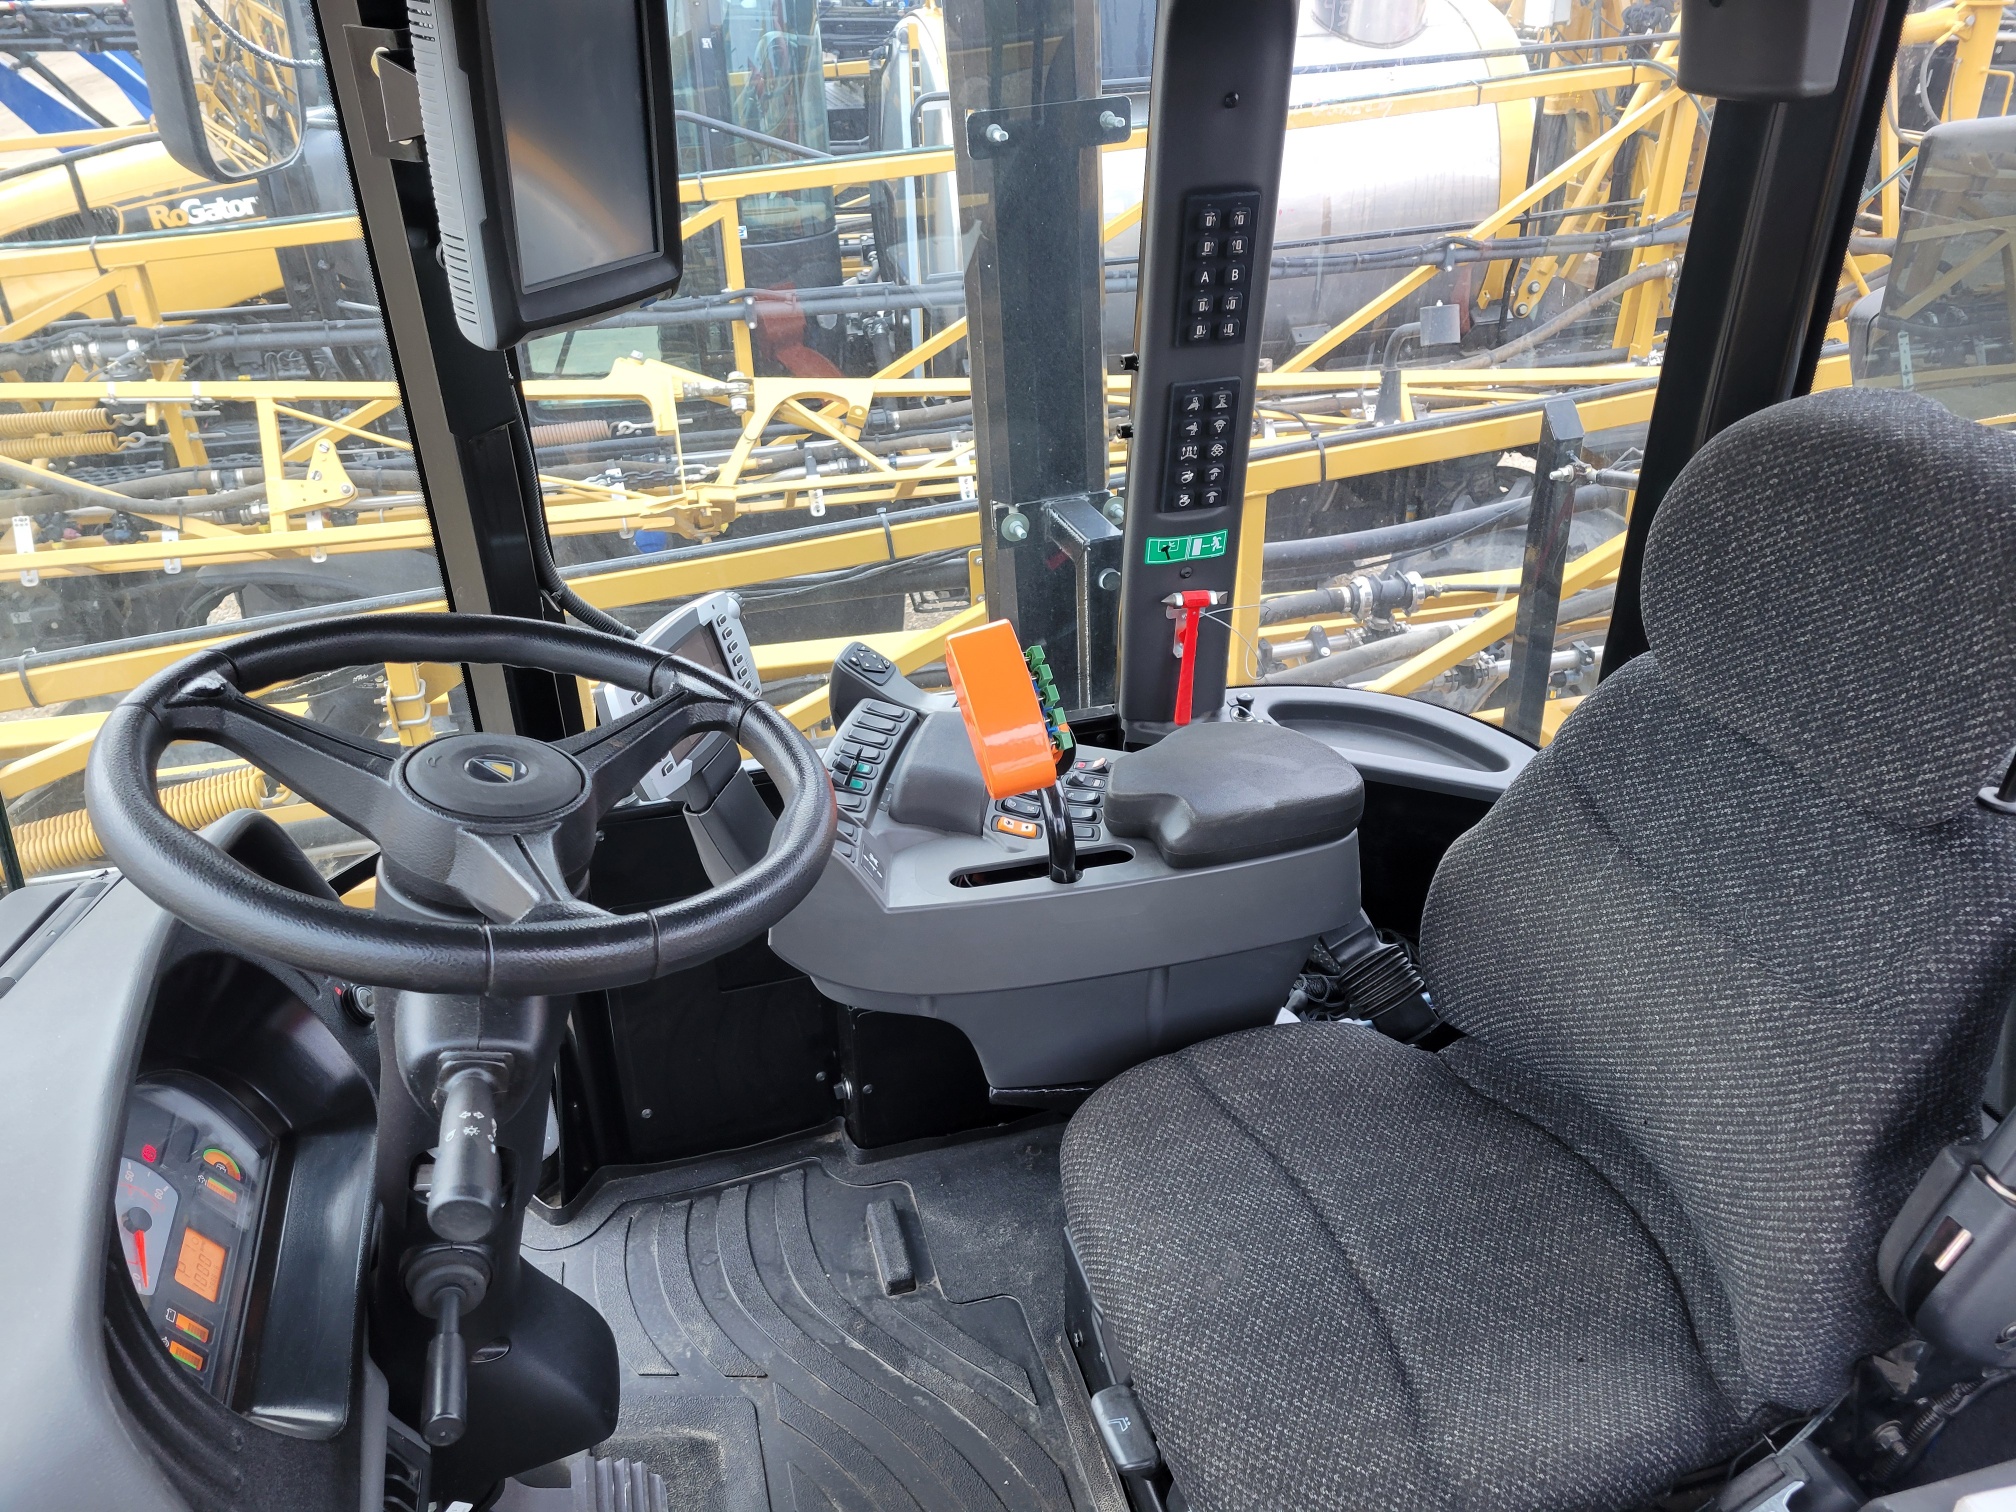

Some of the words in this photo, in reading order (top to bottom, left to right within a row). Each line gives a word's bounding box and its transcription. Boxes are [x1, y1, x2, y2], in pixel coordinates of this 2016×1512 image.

[147, 197, 257, 230] RoGator
[1200, 271, 1210, 283] A
[1231, 269, 1239, 281] B
[124, 1170, 135, 1182] 50
[154, 1188, 164, 1201] 60
